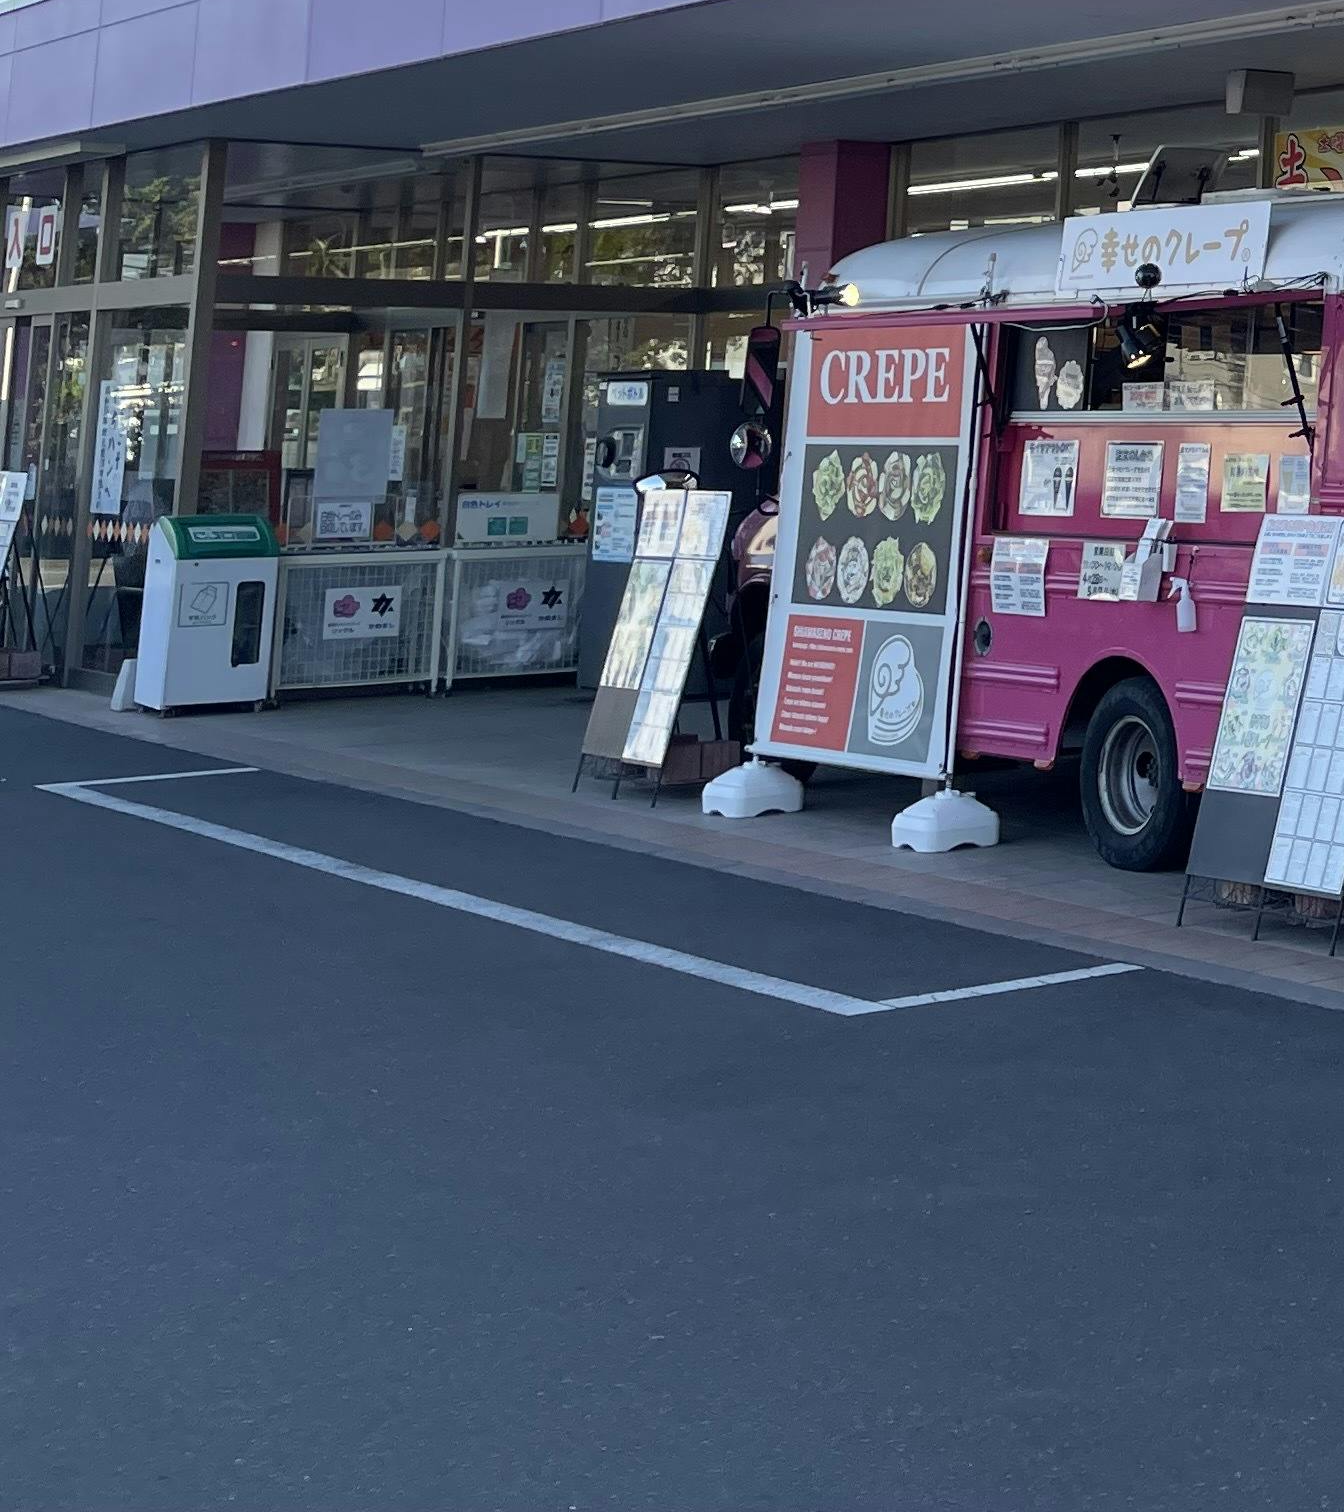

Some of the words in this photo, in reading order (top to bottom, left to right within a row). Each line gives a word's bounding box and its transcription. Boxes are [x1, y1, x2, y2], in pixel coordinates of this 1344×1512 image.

[1101, 219, 1249, 274] 幸せのクレープ
[820, 347, 950, 405] CREPE
